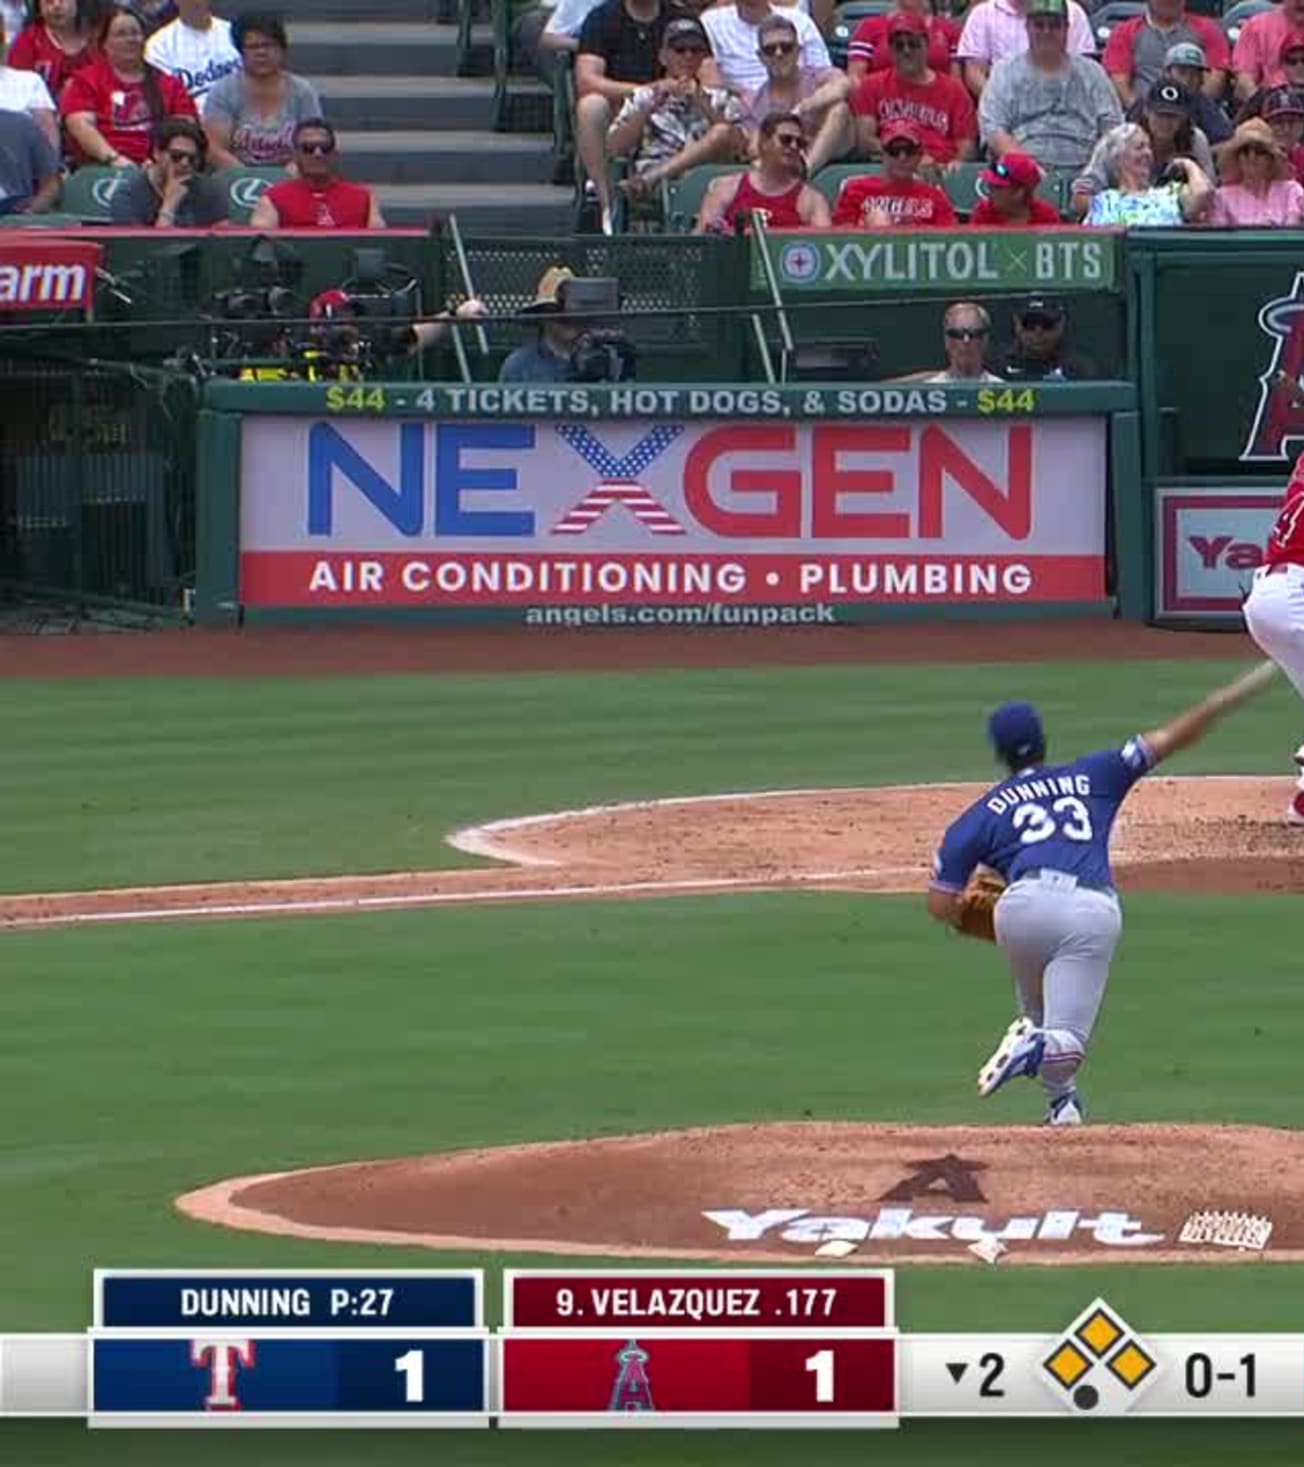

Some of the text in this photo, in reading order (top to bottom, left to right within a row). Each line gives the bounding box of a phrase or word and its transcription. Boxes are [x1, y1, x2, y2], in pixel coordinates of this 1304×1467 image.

[825, 242, 998, 281] XYLITOL
[1036, 241, 1101, 280] BTS
[325, 387, 385, 413] $44
[415, 388, 435, 412] 4
[446, 389, 598, 416] TICKETS,
[610, 390, 673, 414] HOT
[690, 389, 791, 417] DOGS,
[803, 390, 826, 413] &
[838, 389, 947, 414] SODAS
[976, 388, 1036, 414] $44
[308, 421, 1033, 541] NEXGEN
[309, 561, 1032, 596] AIR CONDITIONING PLUMBING
[526, 601, 836, 627] angels.com/funpack
[986, 774, 1091, 815] DUNNING
[1012, 796, 1093, 843] 33
[702, 1207, 1166, 1246] Yakult
